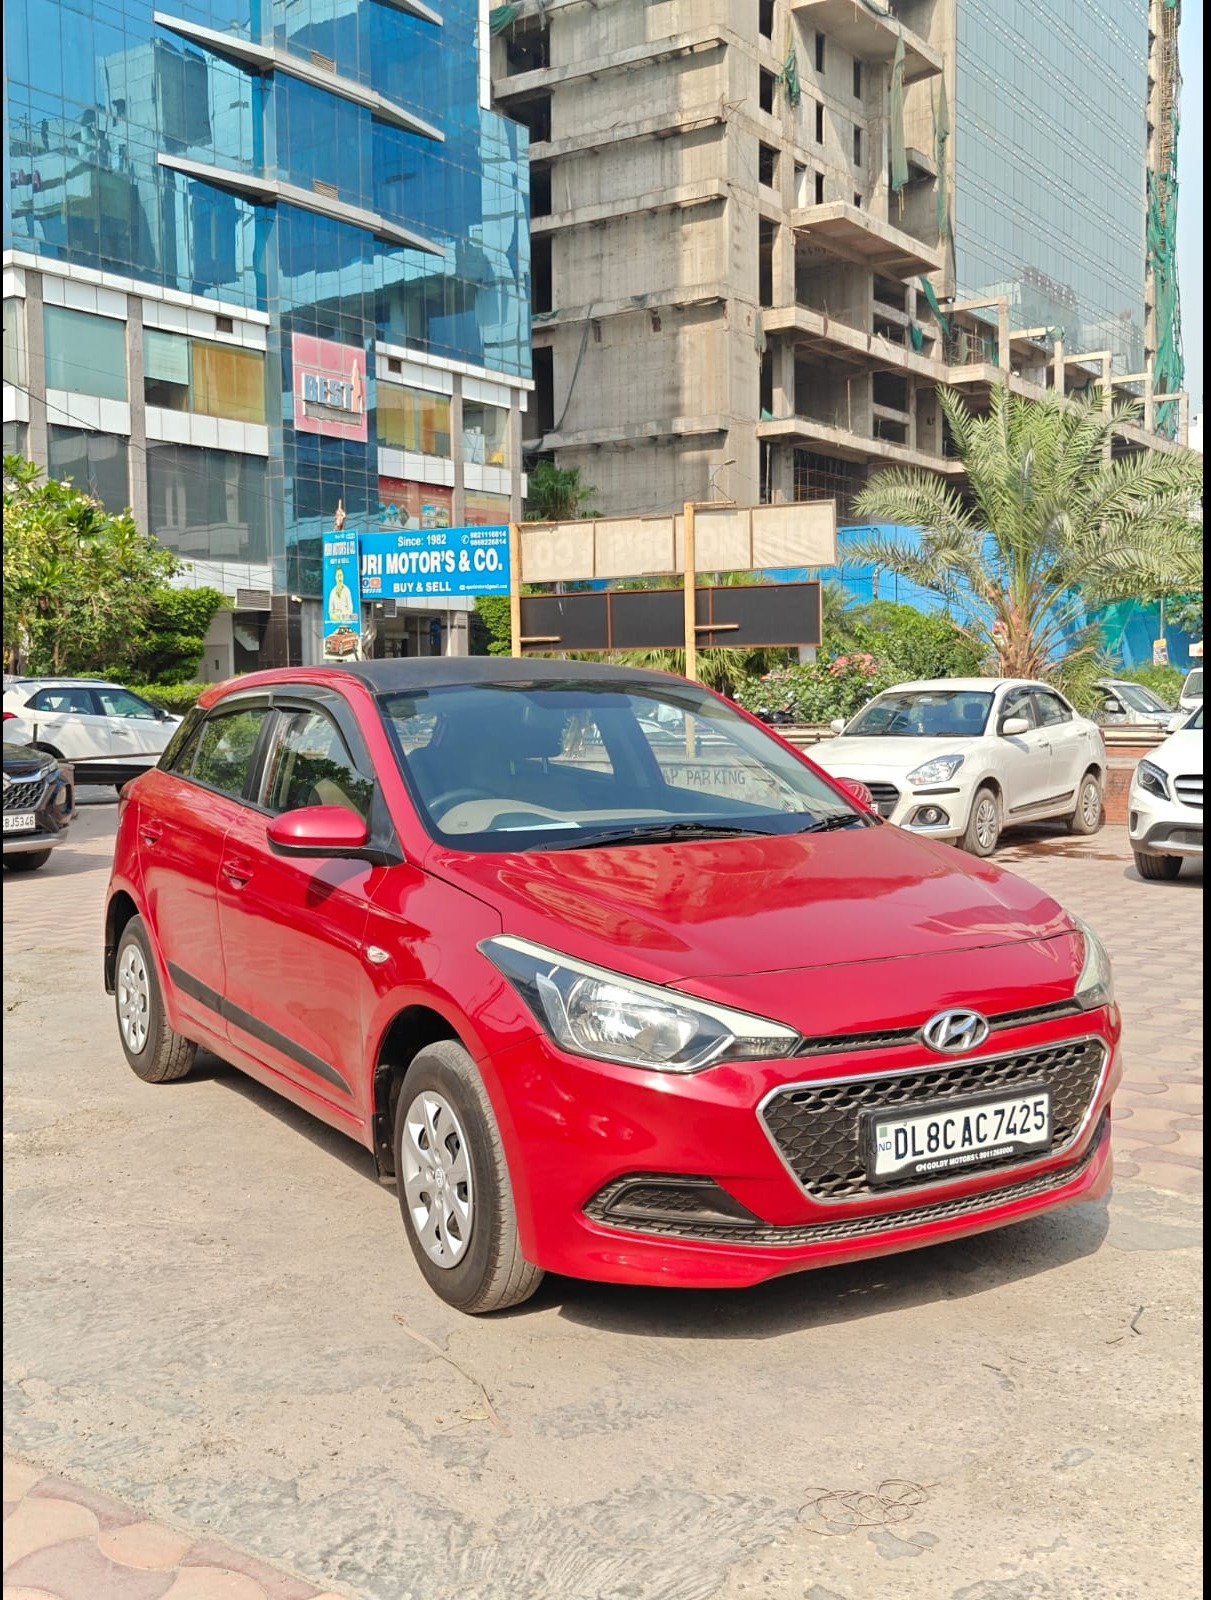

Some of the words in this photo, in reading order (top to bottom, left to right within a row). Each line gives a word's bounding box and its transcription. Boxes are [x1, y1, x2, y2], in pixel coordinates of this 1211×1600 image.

[301, 372, 353, 409] BEST
[397, 535, 424, 547] Since:
[426, 534, 447, 545] 1982
[386, 550, 455, 575] MOTOR'S
[458, 550, 471, 572] &
[474, 548, 503, 571] CO.
[393, 583, 414, 593] BUY
[416, 582, 424, 592] &
[425, 581, 452, 592] SELL
[686, 768, 746, 785] PARKING
[894, 1100, 1045, 1161] DL8CAC7425
[926, 1159, 949, 1170] GOLDY
[949, 1153, 975, 1166] MOTORS
